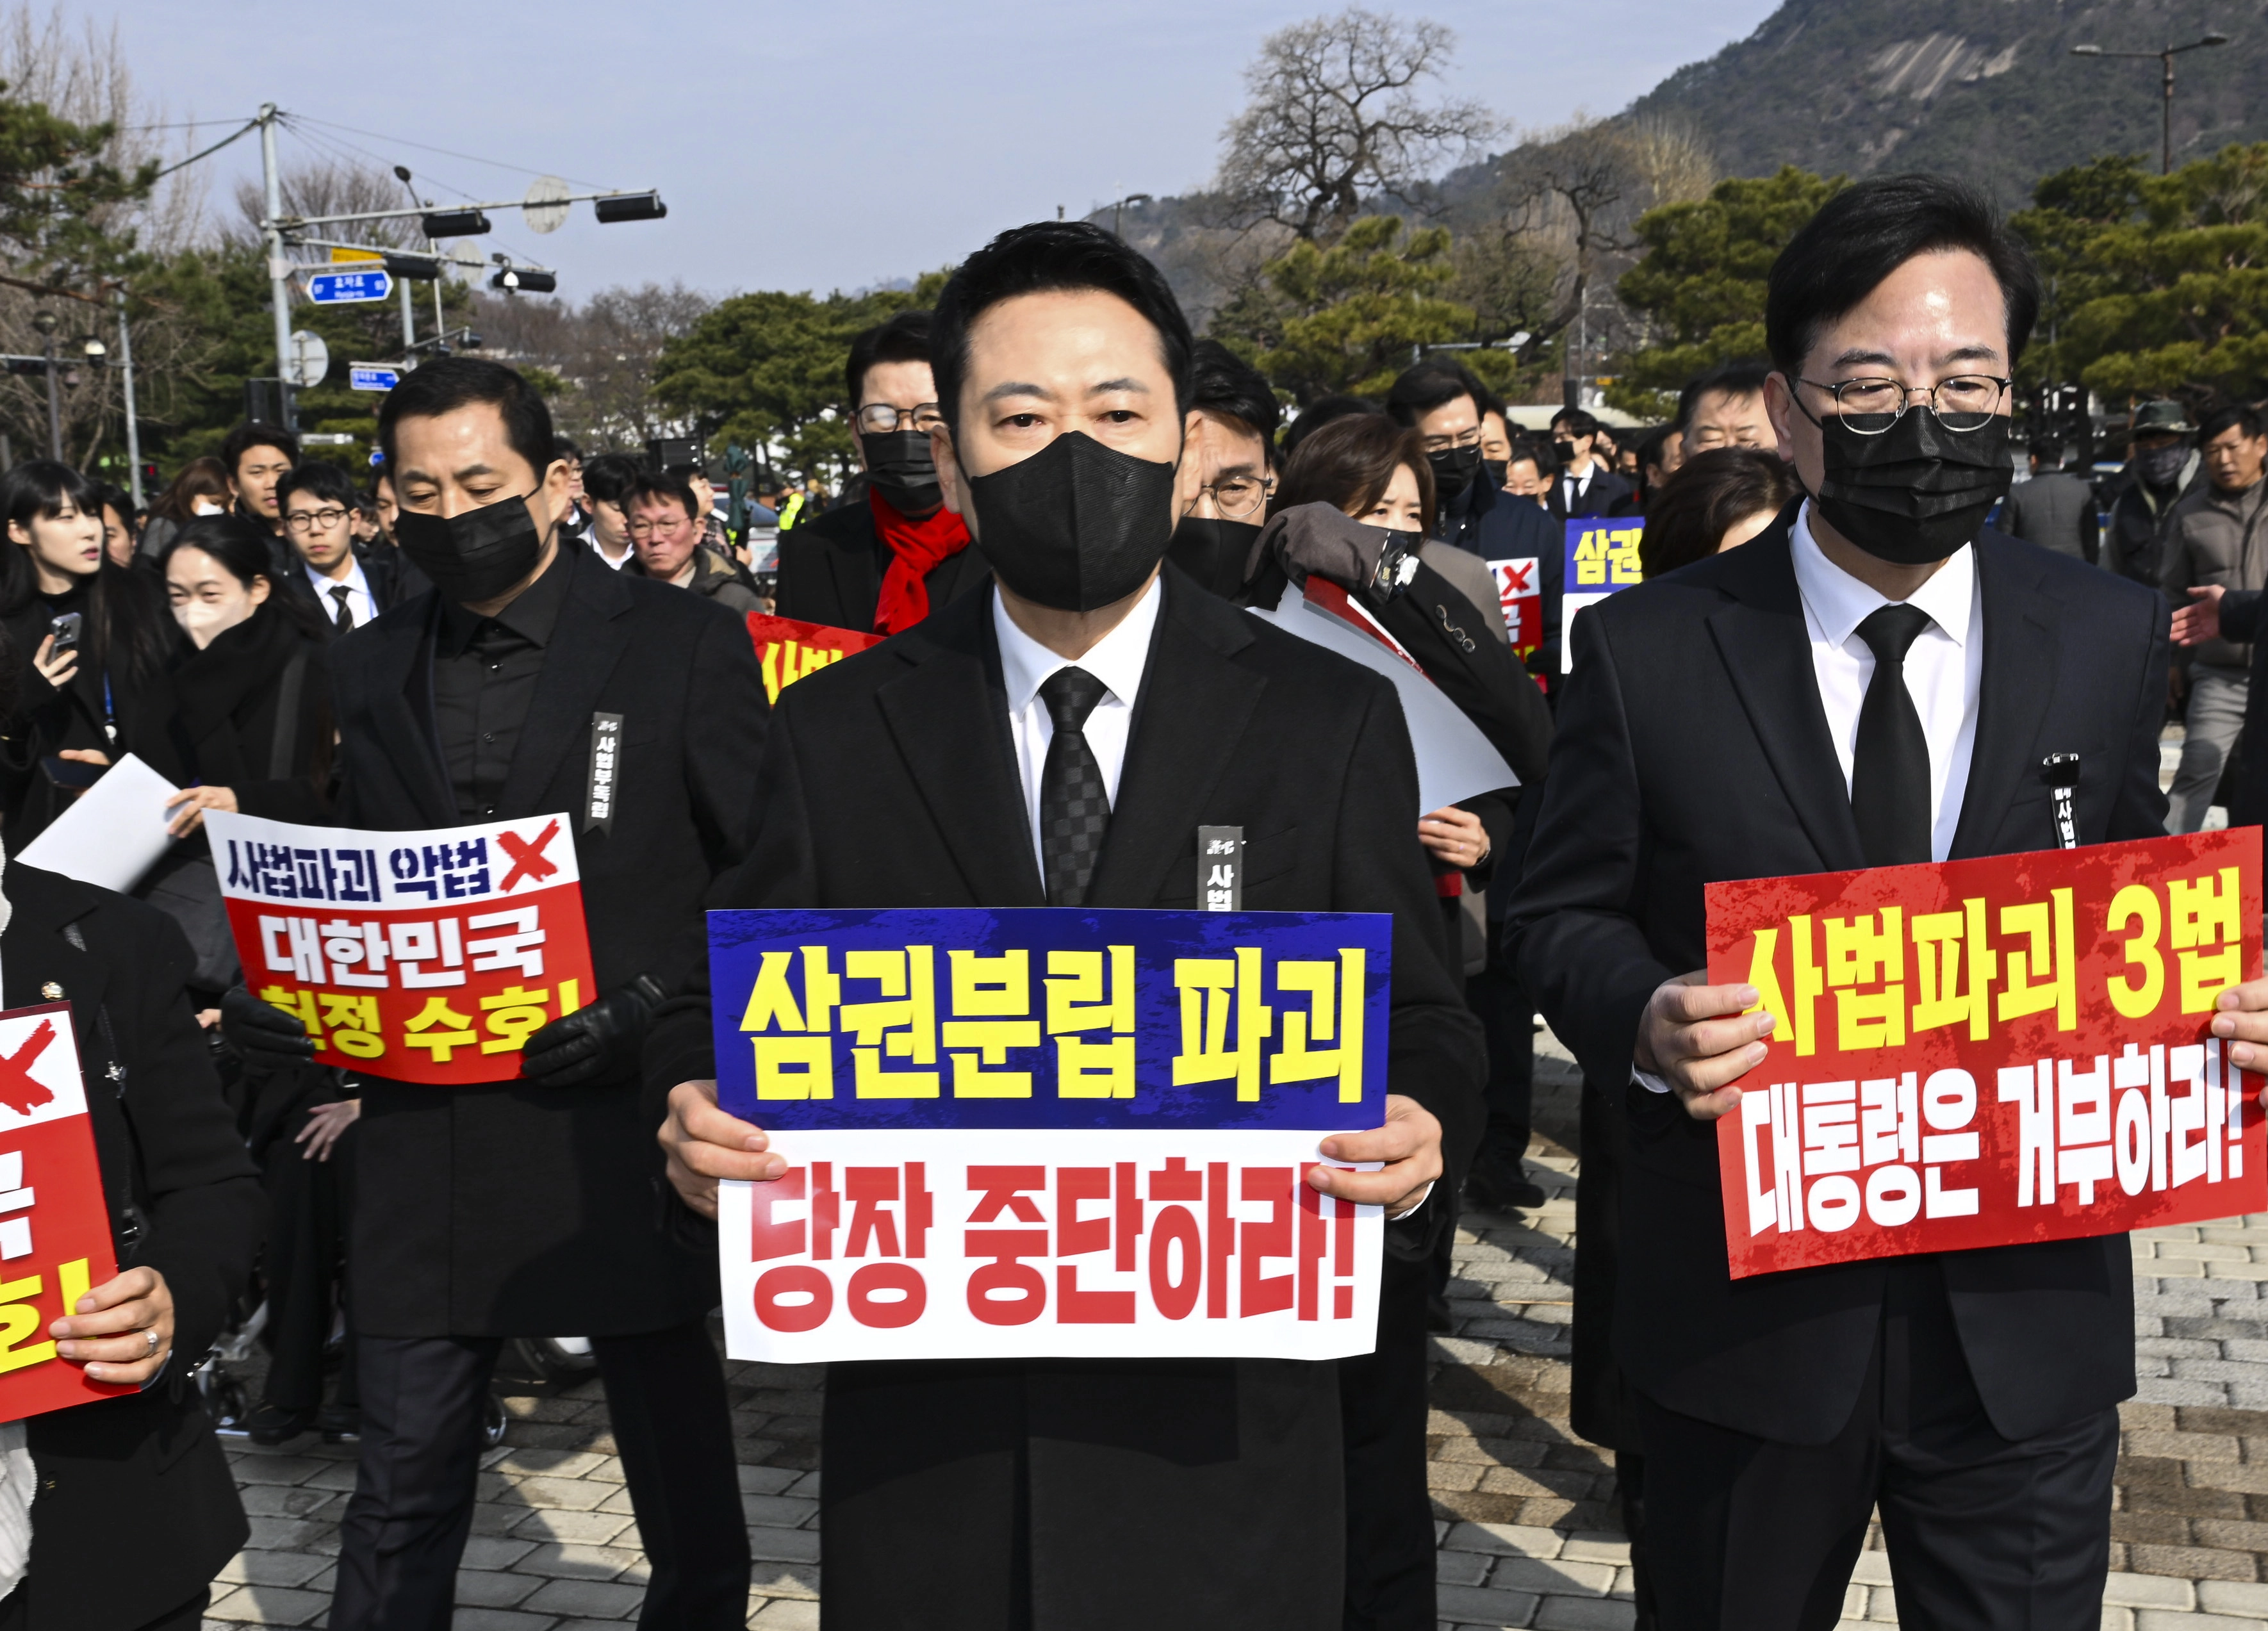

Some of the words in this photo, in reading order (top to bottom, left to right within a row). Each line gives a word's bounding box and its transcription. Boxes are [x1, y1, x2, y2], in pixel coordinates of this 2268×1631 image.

[1573, 527, 1643, 584] 삼권
[227, 839, 381, 903] 사법파괴
[390, 837, 491, 901] 악법
[259, 905, 546, 988] 대한민국
[739, 945, 1135, 1100] 삼권분립
[1172, 947, 1366, 1103] 파괴
[1741, 887, 2076, 1057] 사법파괴
[2107, 867, 2242, 1018] 3법
[1741, 1068, 1980, 1237] 대통령은
[1997, 1037, 2244, 1207] 거부하라!
[750, 1161, 933, 1332] 당장
[965, 1156, 1356, 1325] 중단하라!
